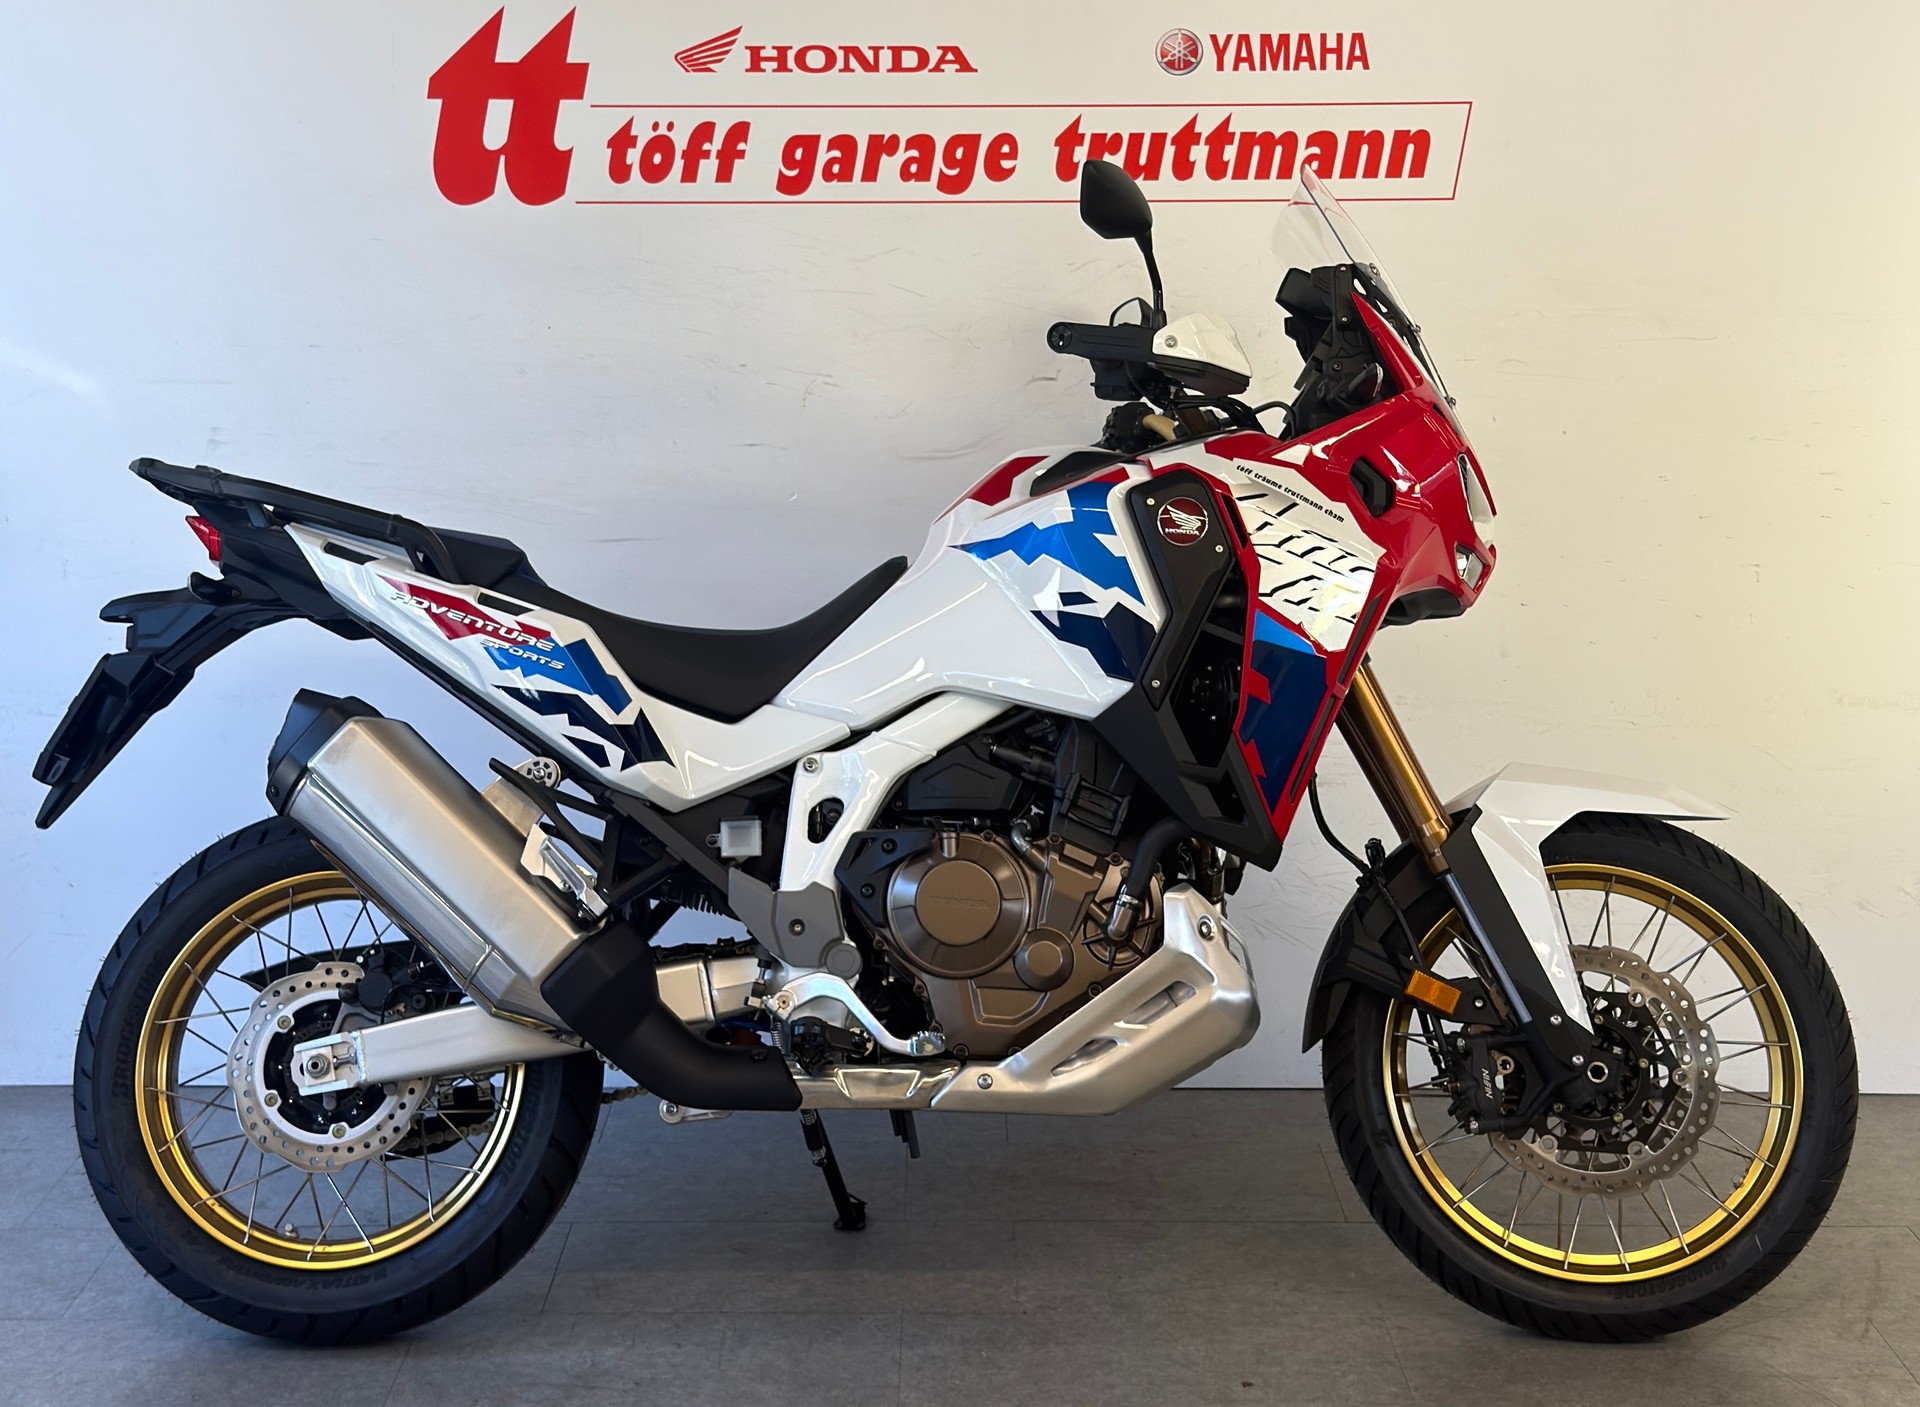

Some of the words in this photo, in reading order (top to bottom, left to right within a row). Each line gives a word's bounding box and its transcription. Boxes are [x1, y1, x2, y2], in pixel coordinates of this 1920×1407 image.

[745, 45, 977, 73] HONDA
[1209, 32, 1370, 72] YAMAHA
[607, 118, 750, 184] töff
[776, 132, 1019, 196] garage
[1054, 114, 1432, 182] truttmann
[1284, 487, 1324, 511] truttmann
[1324, 507, 1345, 523] cham
[1165, 527, 1200, 537] HONDA
[390, 592, 555, 652] ADVENTURE
[480, 638, 566, 670] SPORTS
